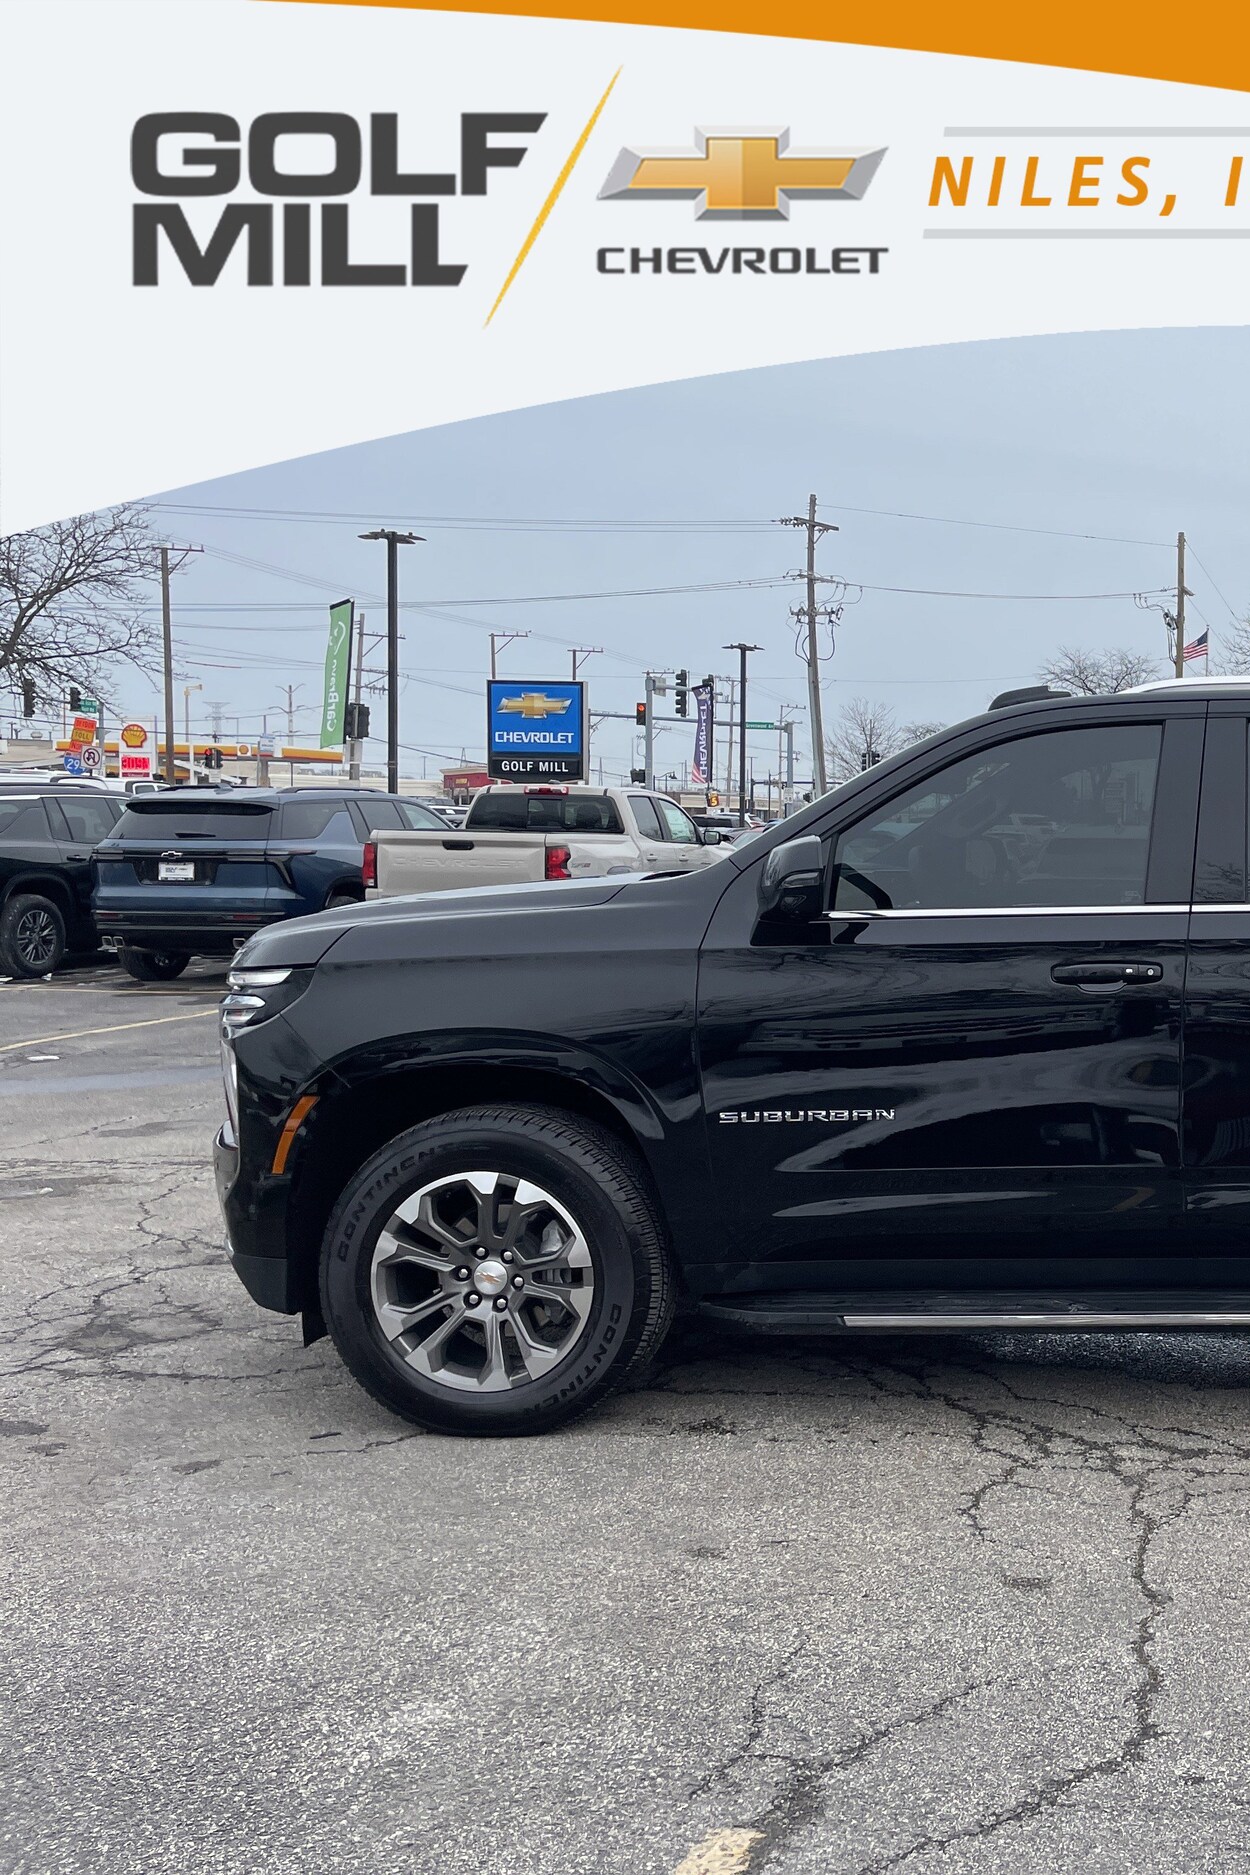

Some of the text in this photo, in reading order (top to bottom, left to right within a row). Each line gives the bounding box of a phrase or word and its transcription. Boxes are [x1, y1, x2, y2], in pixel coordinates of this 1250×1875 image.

[495, 731, 575, 744] CHEVROLET
[66, 758, 85, 772] 29
[501, 760, 569, 772] GOLF MILL
[394, 856, 525, 868] CHEVROLET
[719, 1109, 895, 1124] SUBURBAN
